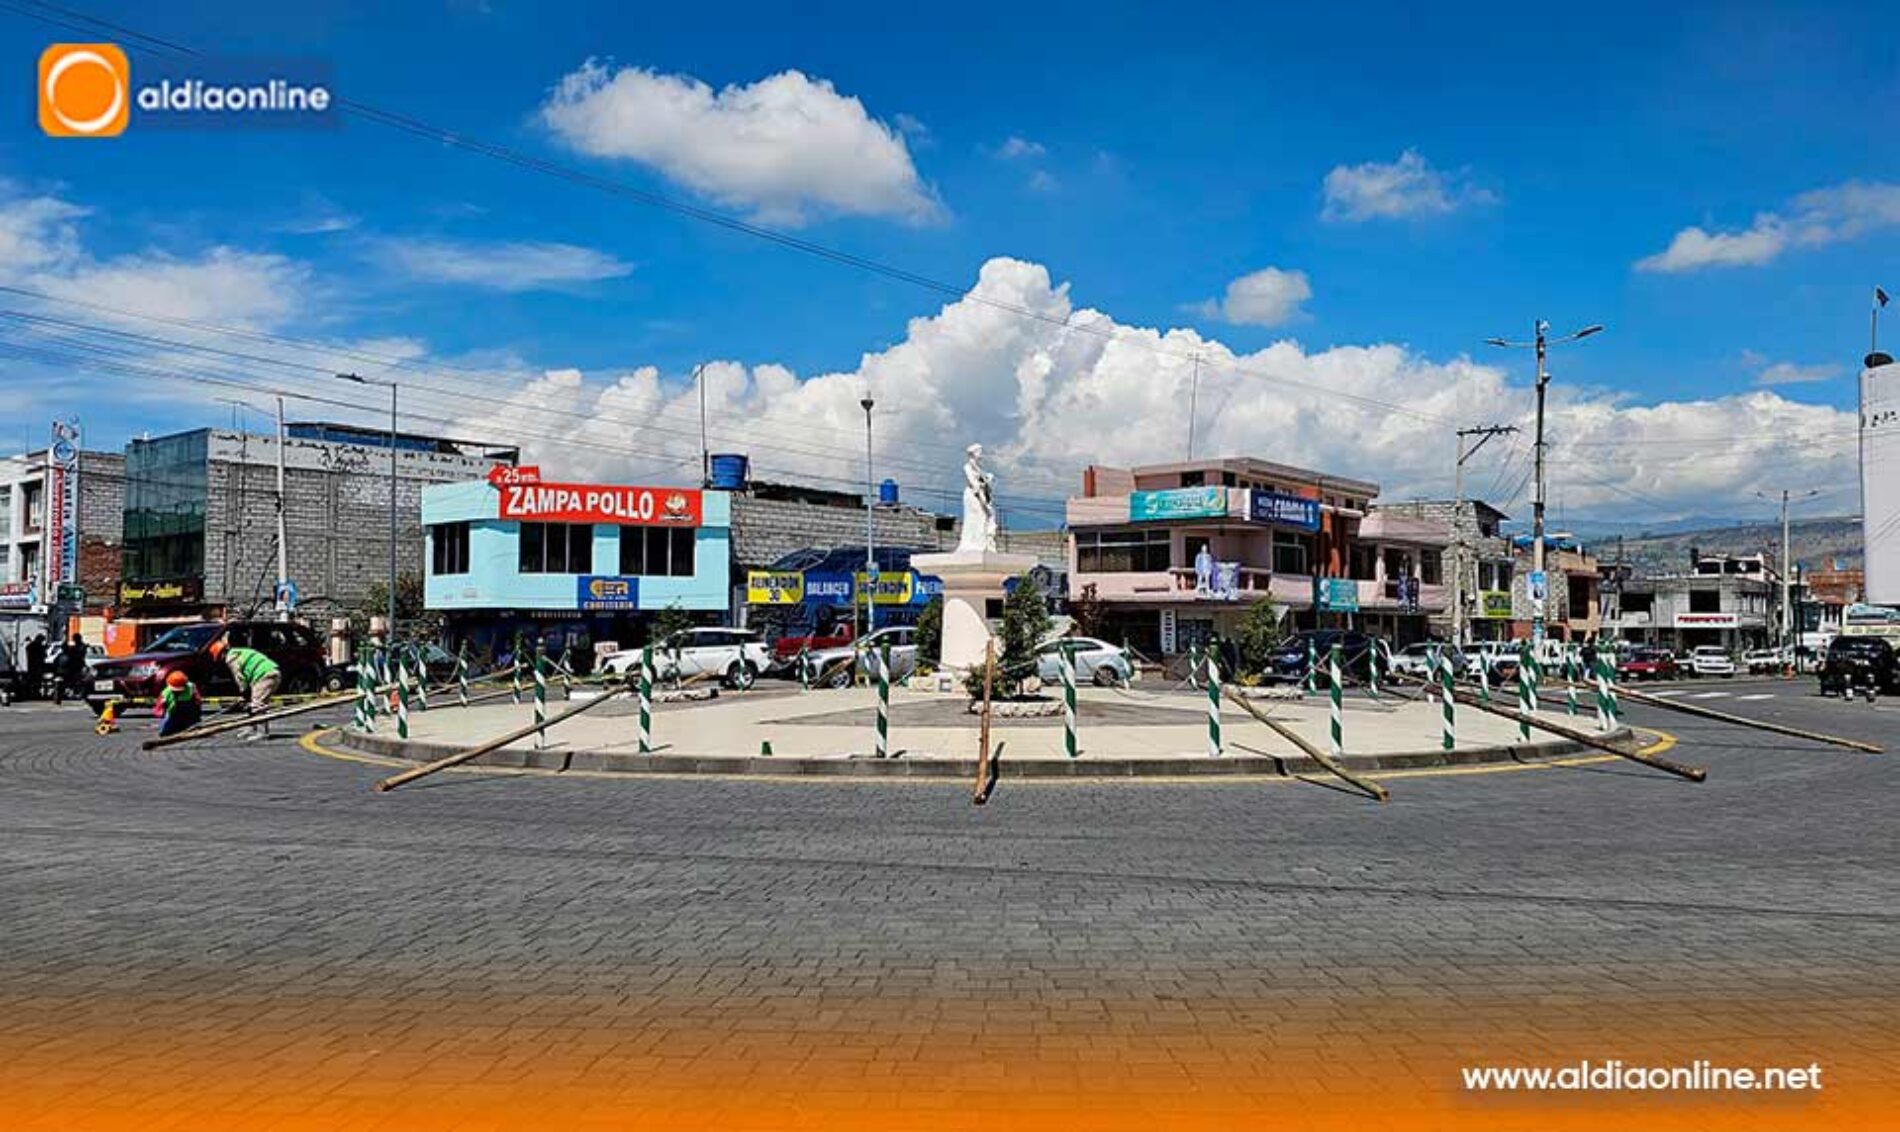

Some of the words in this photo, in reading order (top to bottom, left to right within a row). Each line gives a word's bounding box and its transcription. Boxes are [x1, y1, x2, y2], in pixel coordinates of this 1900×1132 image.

[503, 468, 519, 484] 25
[506, 486, 583, 516] ZAMPA
[586, 491, 654, 520] POLLO
